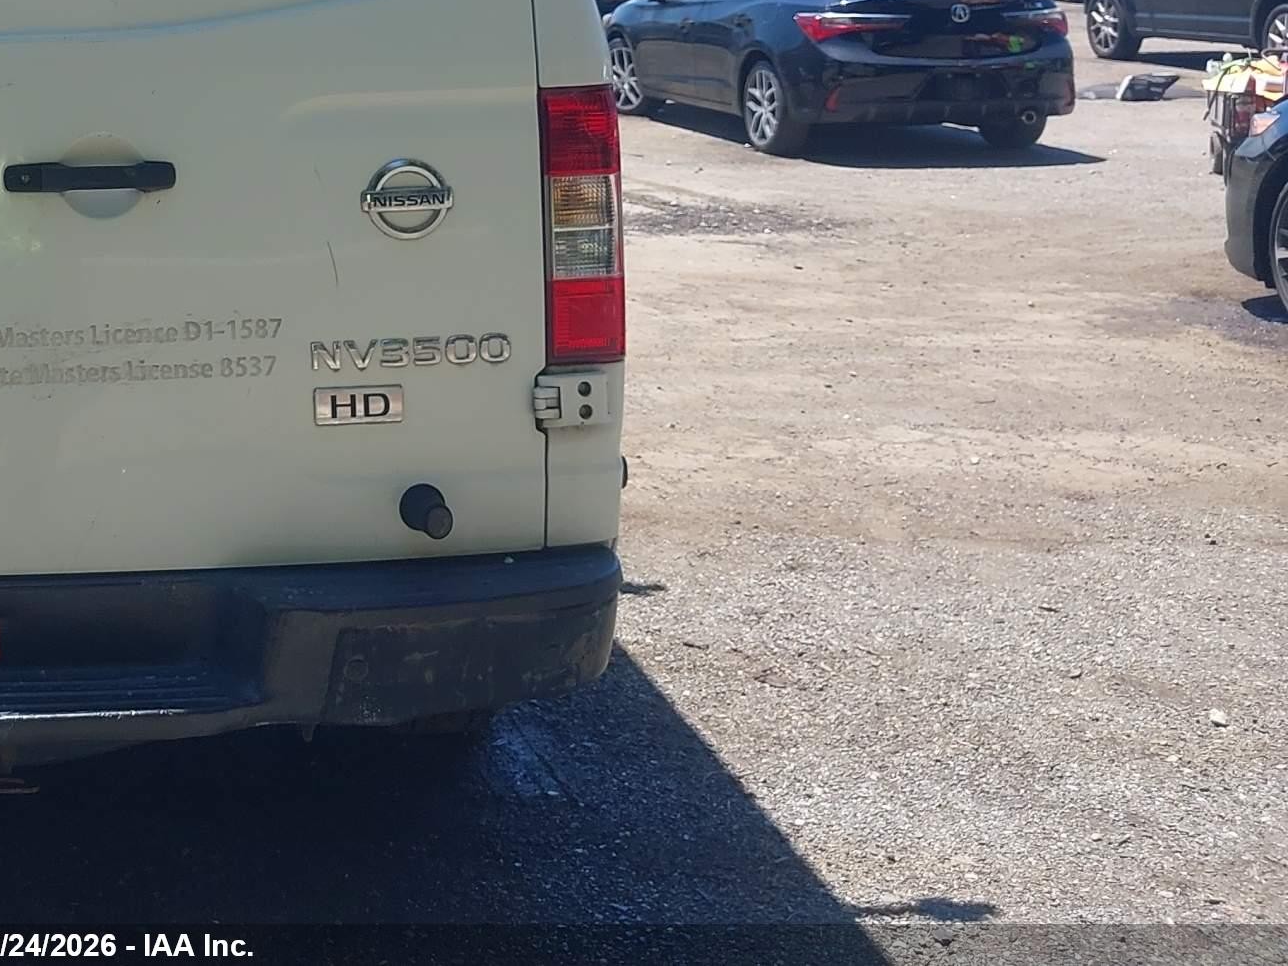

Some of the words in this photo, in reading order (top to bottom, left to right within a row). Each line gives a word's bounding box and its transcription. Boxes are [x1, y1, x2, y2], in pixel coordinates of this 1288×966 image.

[372, 190, 447, 209] NISSAN
[183, 317, 283, 342] D1-1587
[311, 332, 512, 372] NV3500
[219, 354, 277, 378] 8537
[329, 392, 392, 419] HD
